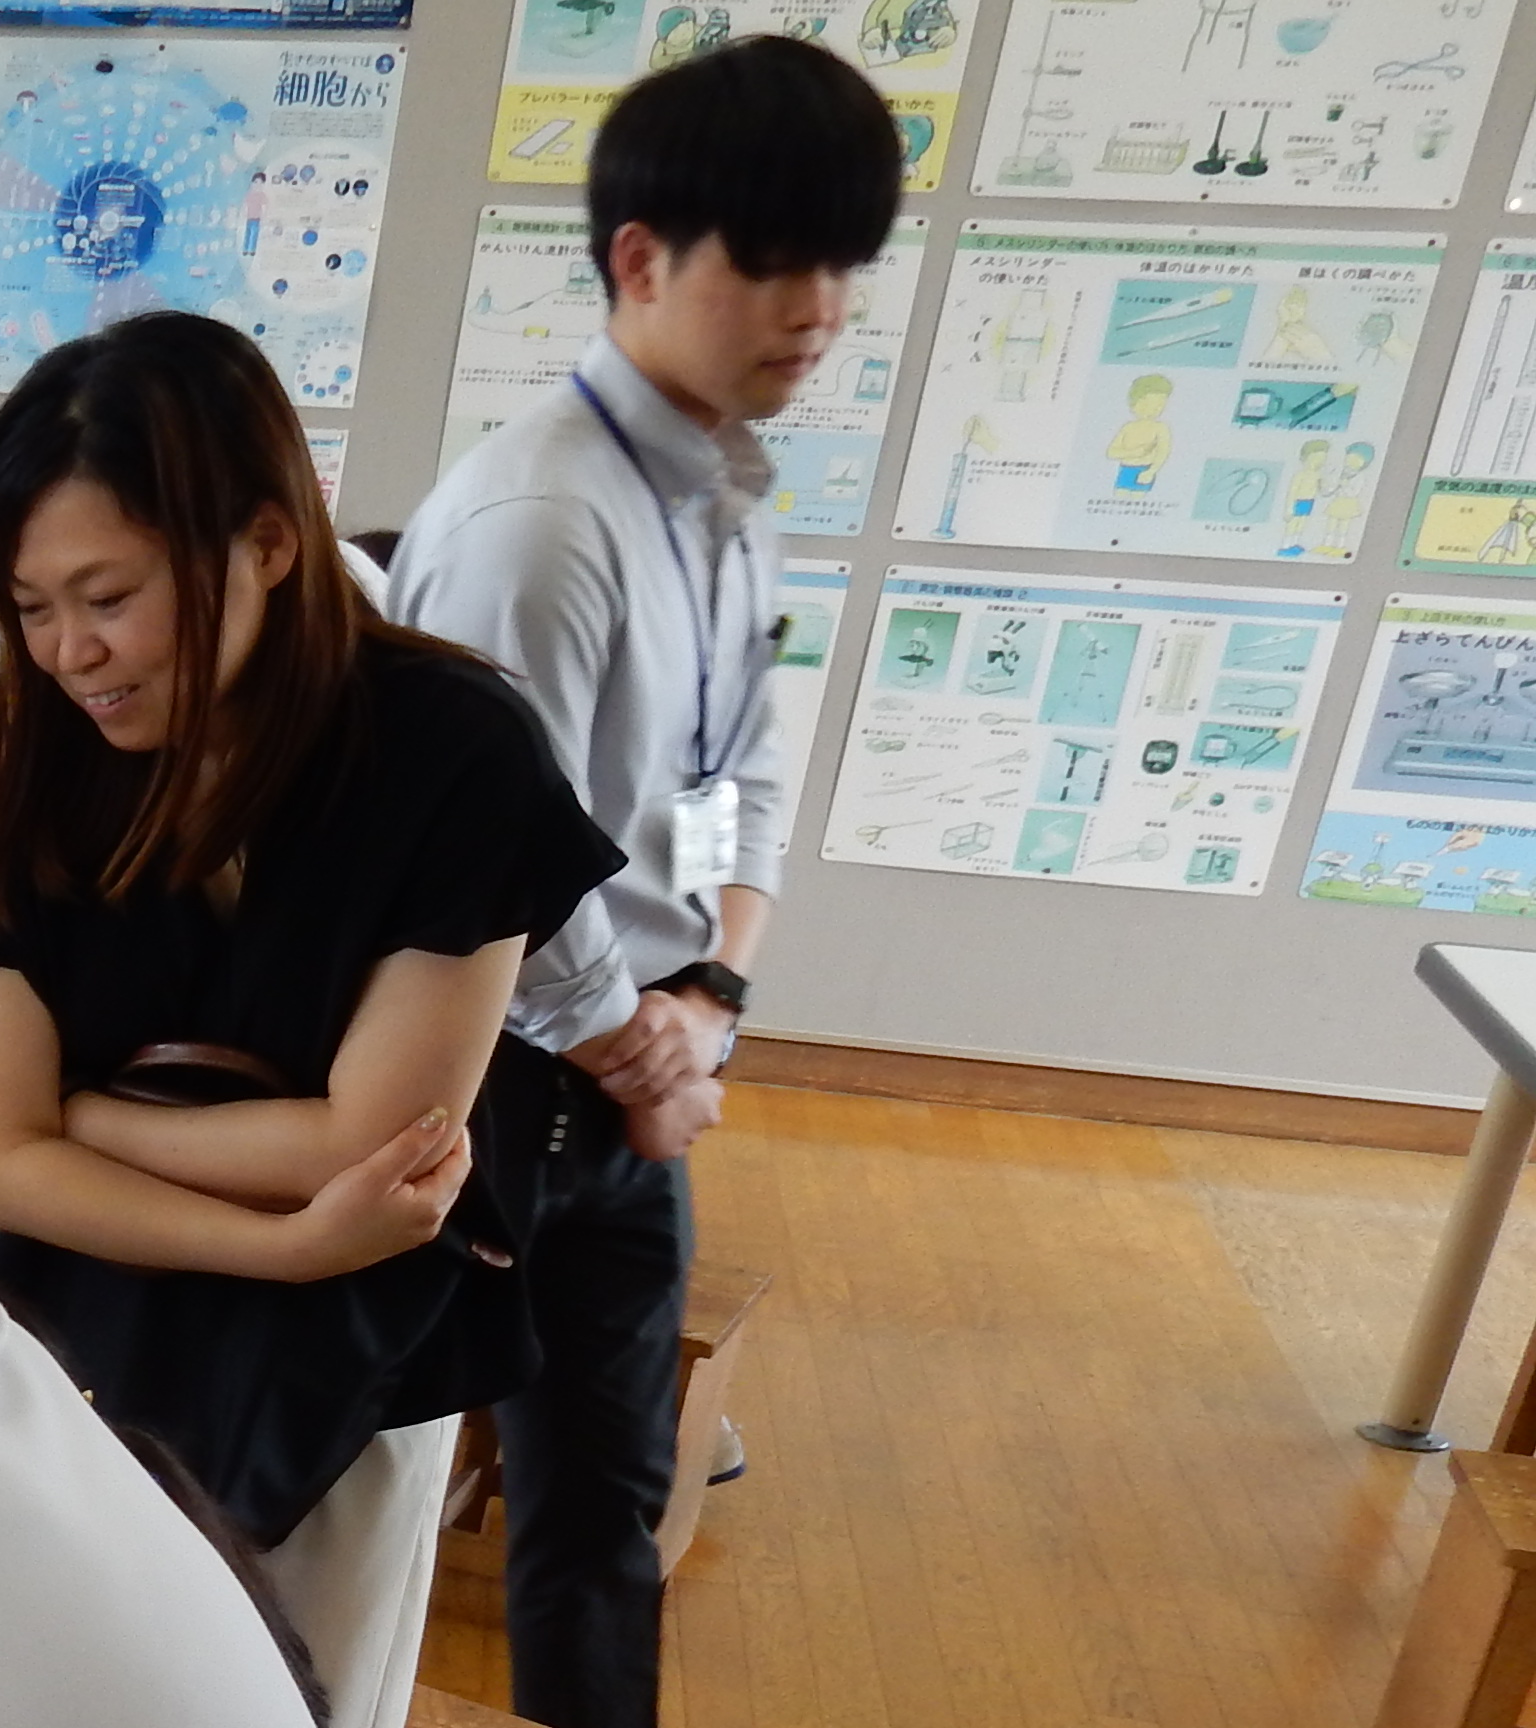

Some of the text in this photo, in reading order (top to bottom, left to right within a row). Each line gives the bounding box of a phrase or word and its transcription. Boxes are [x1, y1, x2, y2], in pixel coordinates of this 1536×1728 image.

[273, 70, 390, 108] 細胞から
[970, 256, 1069, 270] メスシリンダー
[1139, 261, 1255, 278] 体温のはかりかた
[978, 271, 1049, 287] の使いかた
[1298, 266, 1417, 283] 脈はくの調べかた
